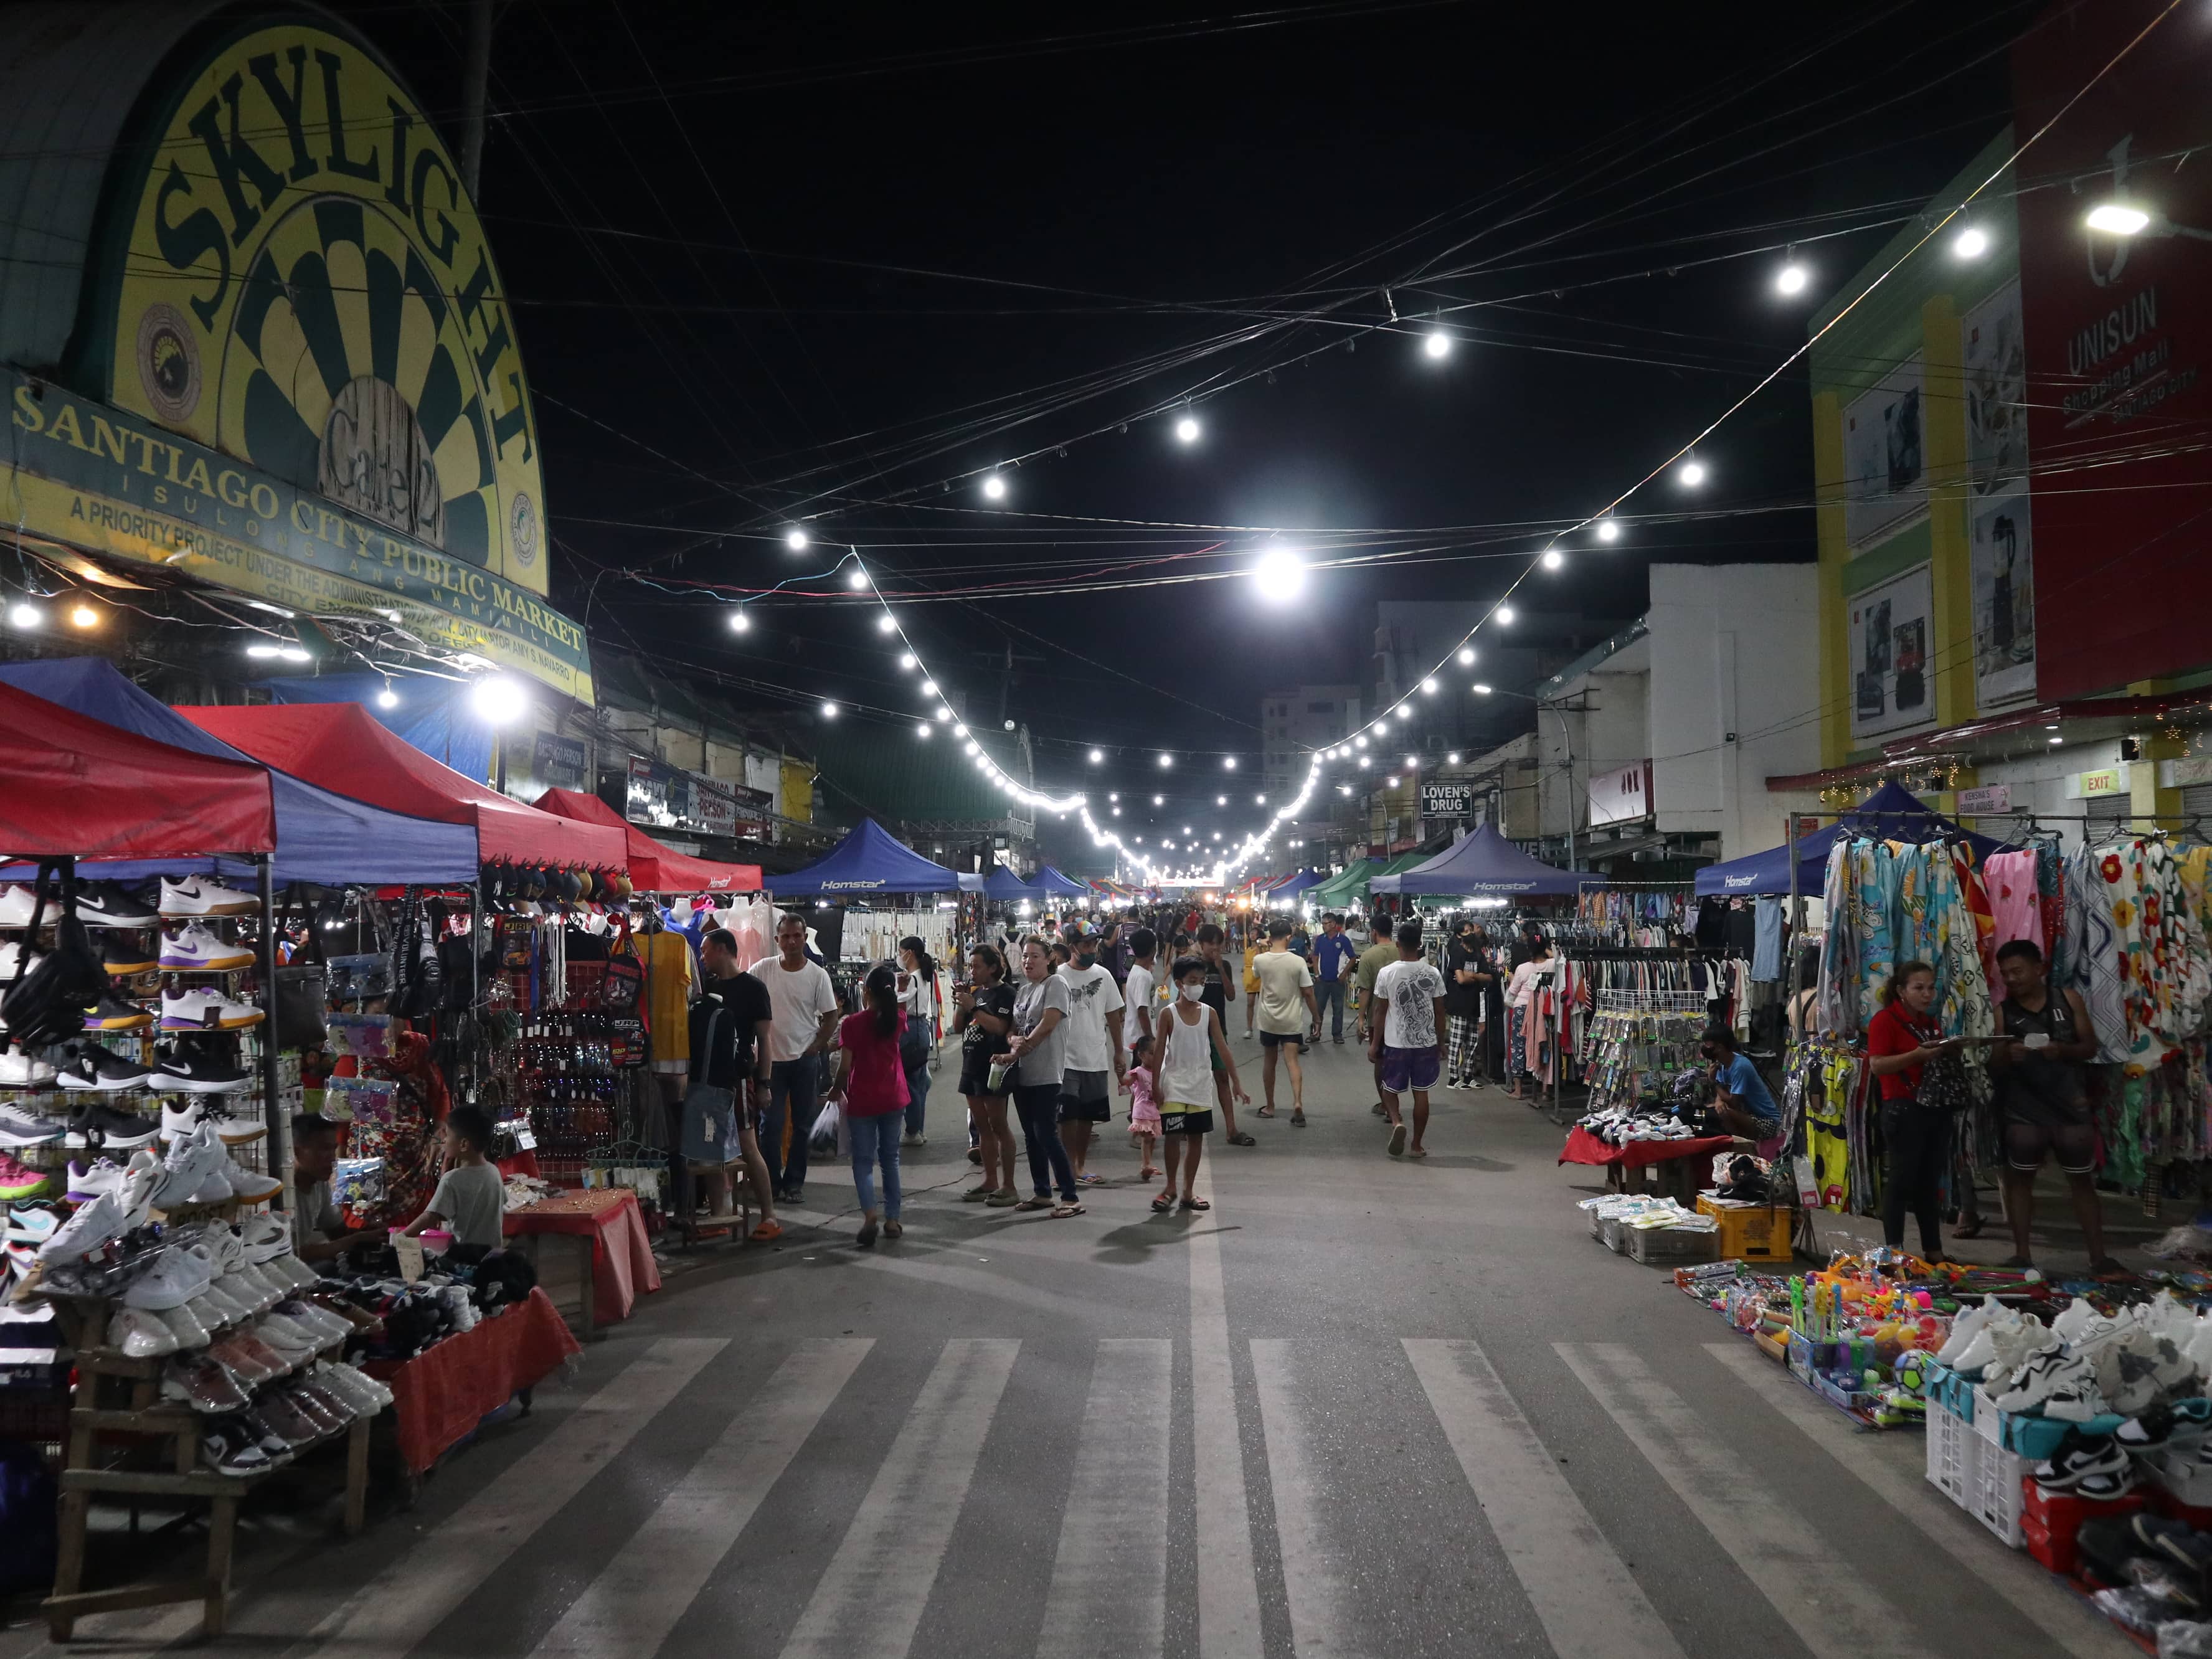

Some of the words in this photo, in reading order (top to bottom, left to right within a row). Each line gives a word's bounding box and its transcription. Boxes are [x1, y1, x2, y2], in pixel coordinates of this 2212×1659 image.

[155, 45, 532, 464] SKYLIGHT
[2068, 285, 2157, 376] UNISUN
[2063, 364, 2132, 415] Shopping
[2134, 338, 2168, 374] Mall
[12, 385, 279, 519] SANTIAGO
[290, 499, 376, 559] CITY
[381, 539, 486, 602] PUBLIC
[491, 581, 583, 652] MARKET
[70, 496, 85, 519] A
[90, 503, 169, 546] PRIORITY
[174, 529, 243, 567] PROJECT
[247, 551, 291, 584] UNDER
[296, 567, 319, 592] THE
[323, 577, 417, 620] ADMINISTRATION
[458, 622, 478, 641] CITY
[513, 639, 529, 659] AMY
[530, 648, 538, 664] S.
[539, 653, 570, 681] NAVARRO
[1422, 786, 1470, 799] LOVEN'S
[2088, 776, 2110, 791] EXIT
[699, 796, 726, 820] PERSON
[1430, 799, 1463, 811] DRUG
[1960, 803, 1974, 813] FOOD
[1976, 800, 1994, 811] HOUSE
[820, 879, 882, 890] Homstar
[1473, 882, 1533, 891] Homstar
[1724, 874, 1757, 887] Homstar
[399, 937, 410, 985] VOLUNTEER
